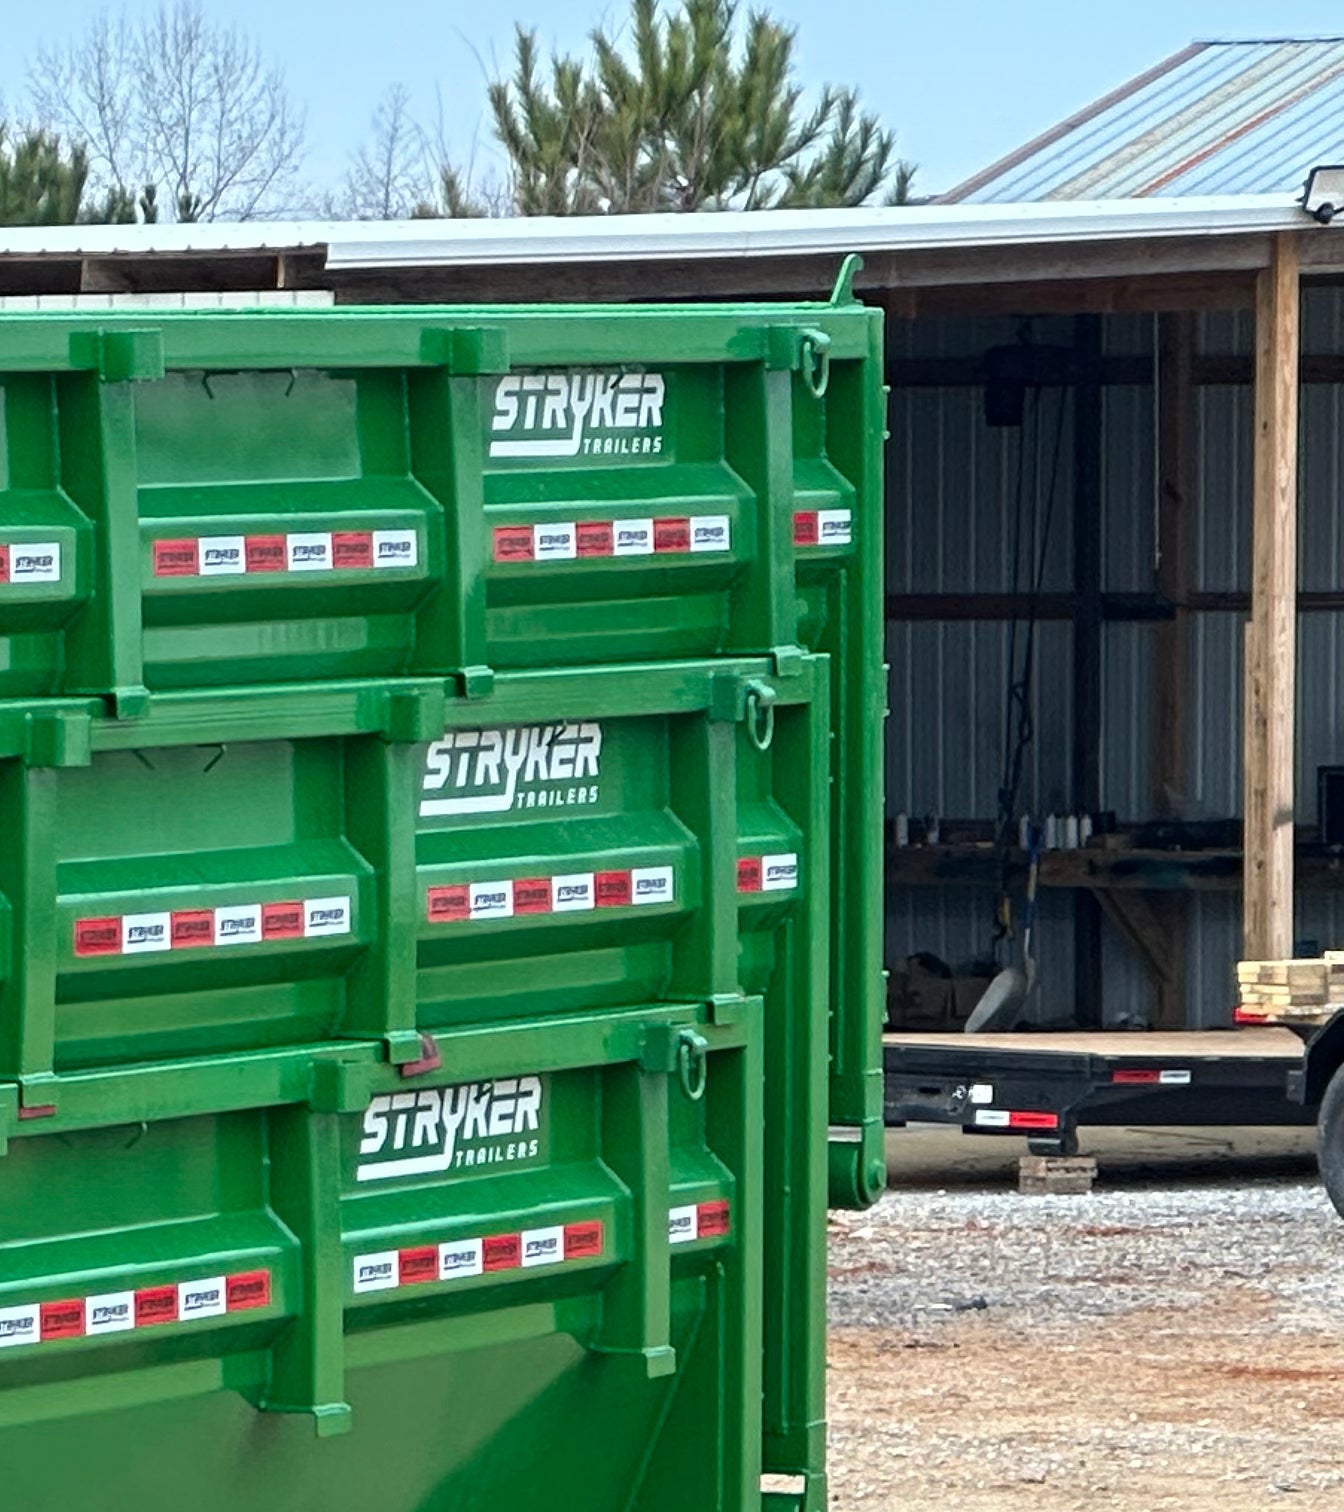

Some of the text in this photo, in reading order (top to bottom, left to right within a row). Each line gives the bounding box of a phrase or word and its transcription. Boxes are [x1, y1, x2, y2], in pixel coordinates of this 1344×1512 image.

[489, 373, 664, 457] STRYKER
[583, 436, 662, 454] TRAILERS
[419, 722, 601, 816] STRYKER
[516, 786, 598, 808] TRAILERS
[357, 1076, 541, 1181] STRYKER
[454, 1140, 538, 1167] TRAILERS
